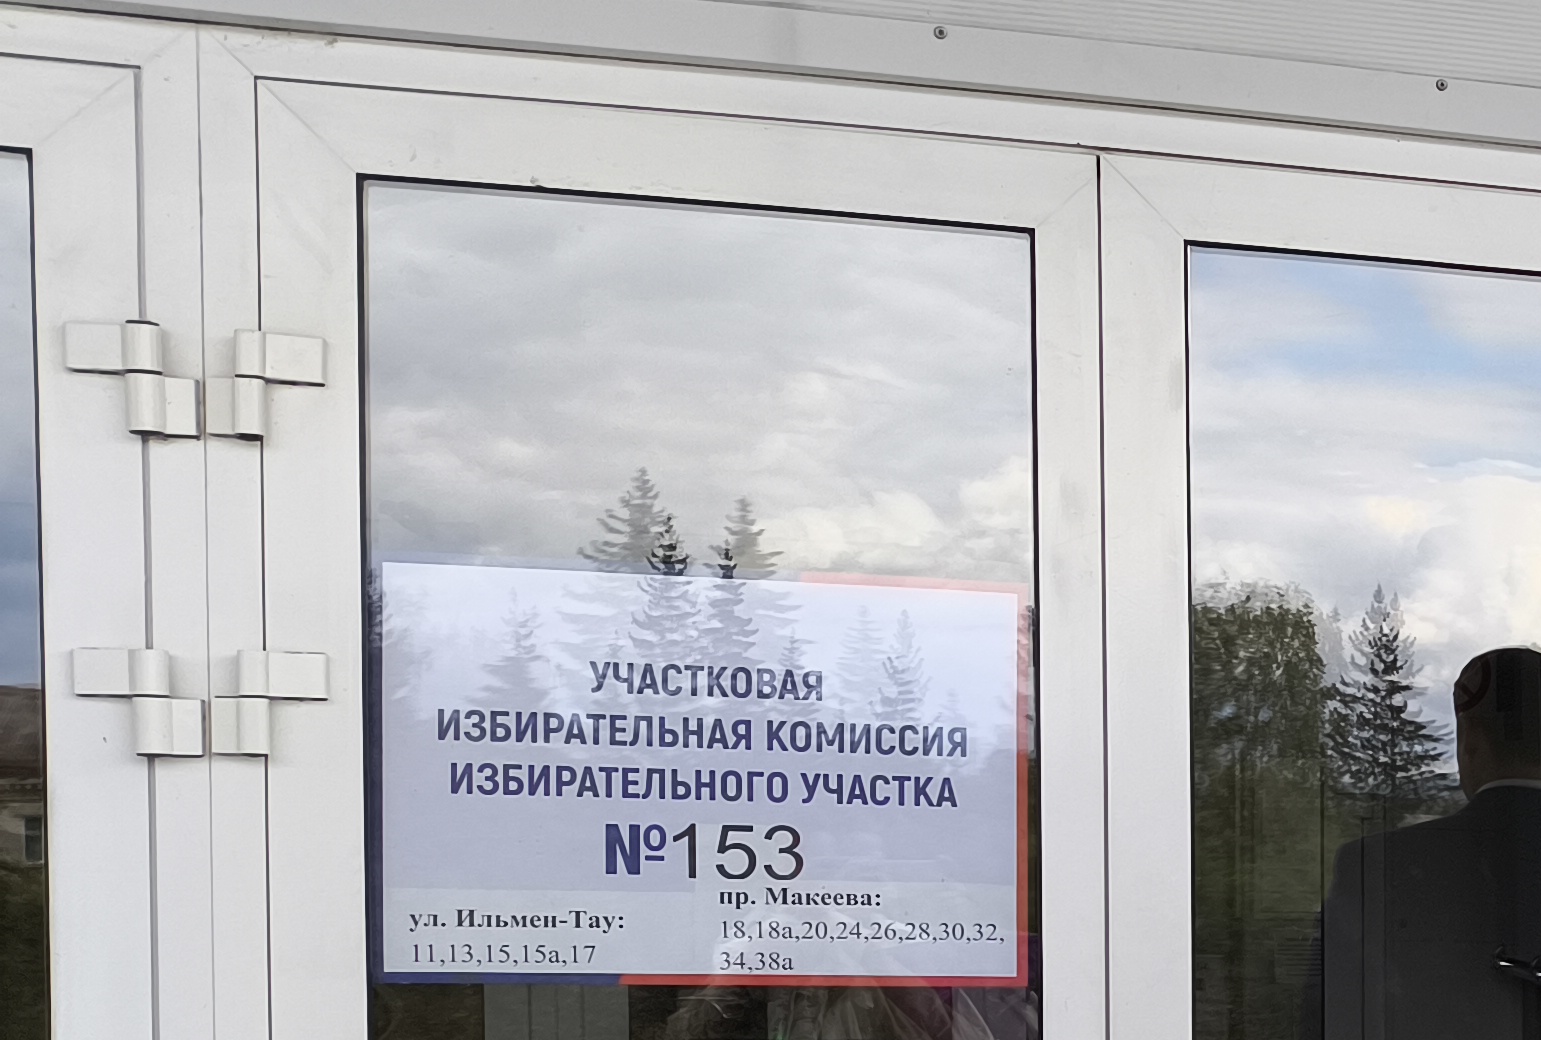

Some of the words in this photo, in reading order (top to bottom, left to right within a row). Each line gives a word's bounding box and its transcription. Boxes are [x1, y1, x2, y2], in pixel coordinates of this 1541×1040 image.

[589, 661, 823, 701] УЧАСТКОВАЯ
[437, 708, 752, 751] ИЗБИРАТЕЛЬНАЯ
[766, 719, 968, 758] КОМИССИЯ
[450, 762, 789, 804] ИЗБИРАТЕЛЬНОГО
[800, 772, 958, 808] УЧАСТКА
[719, 889, 756, 909] пр.
[764, 887, 882, 907] Макеева:
[409, 912, 447, 932] ул.
[455, 908, 625, 934] Ильмен-Тау:
[411, 943, 597, 967] 11,13,15,15а,17
[719, 951, 794, 973] 34,38а
